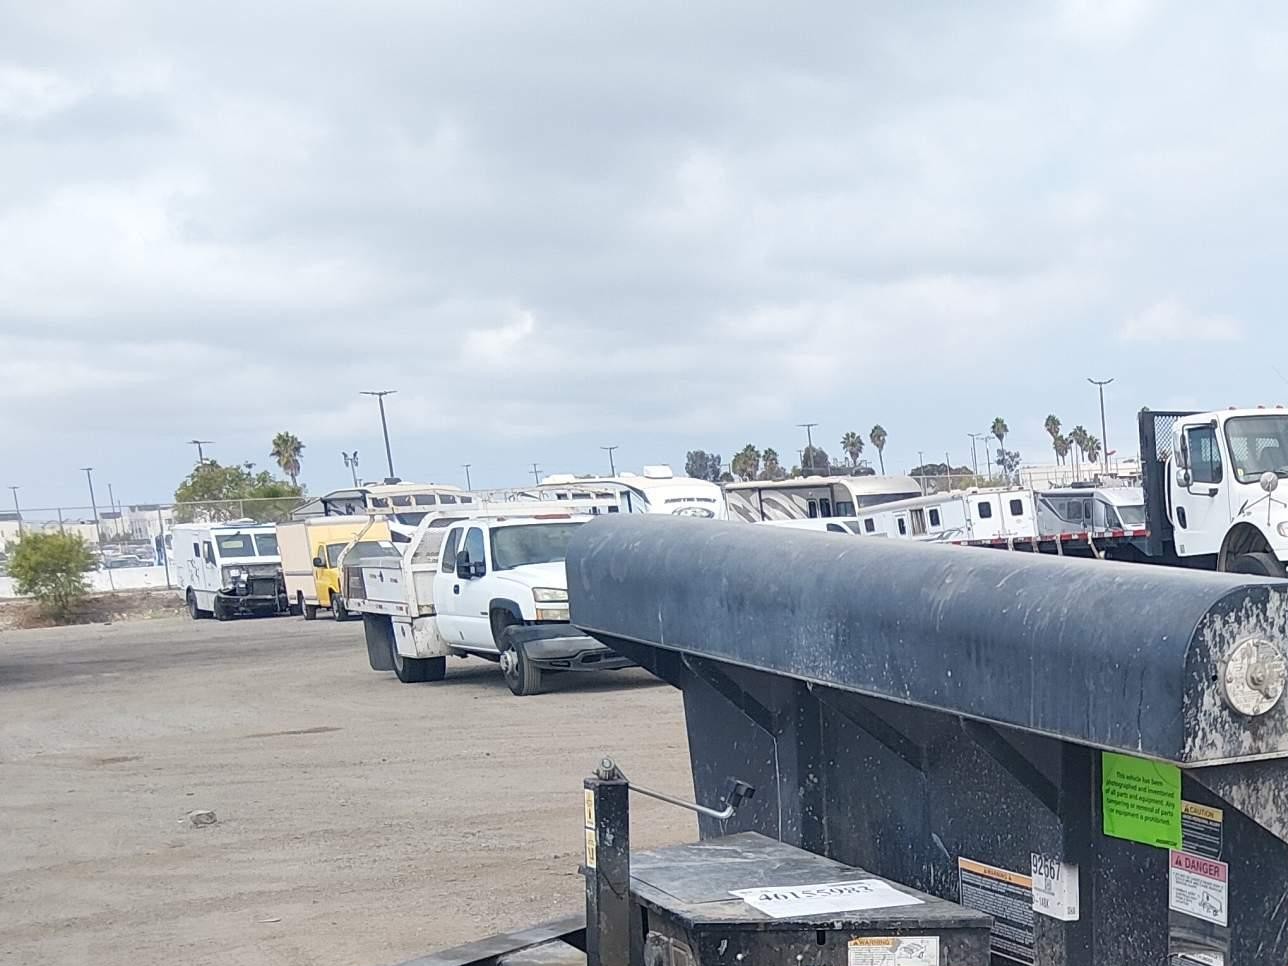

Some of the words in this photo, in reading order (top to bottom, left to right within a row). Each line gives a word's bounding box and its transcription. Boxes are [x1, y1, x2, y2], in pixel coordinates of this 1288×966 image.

[1116, 771, 1125, 779] This
[1142, 776, 1150, 784] has
[1151, 778, 1163, 786] been
[1106, 779, 1138, 790] photographed
[1138, 785, 1147, 793] and
[1148, 787, 1175, 798] inventoried
[1106, 798, 1130, 809] tampering
[1136, 804, 1154, 812] removal
[1161, 810, 1173, 818] parts
[1117, 791, 1128, 799] parts
[1166, 801, 1175, 809] Any
[1115, 809, 1139, 819] equipment
[1190, 807, 1214, 819] CAUTION
[1185, 857, 1220, 877] DANGER
[859, 938, 890, 946] WARNING
